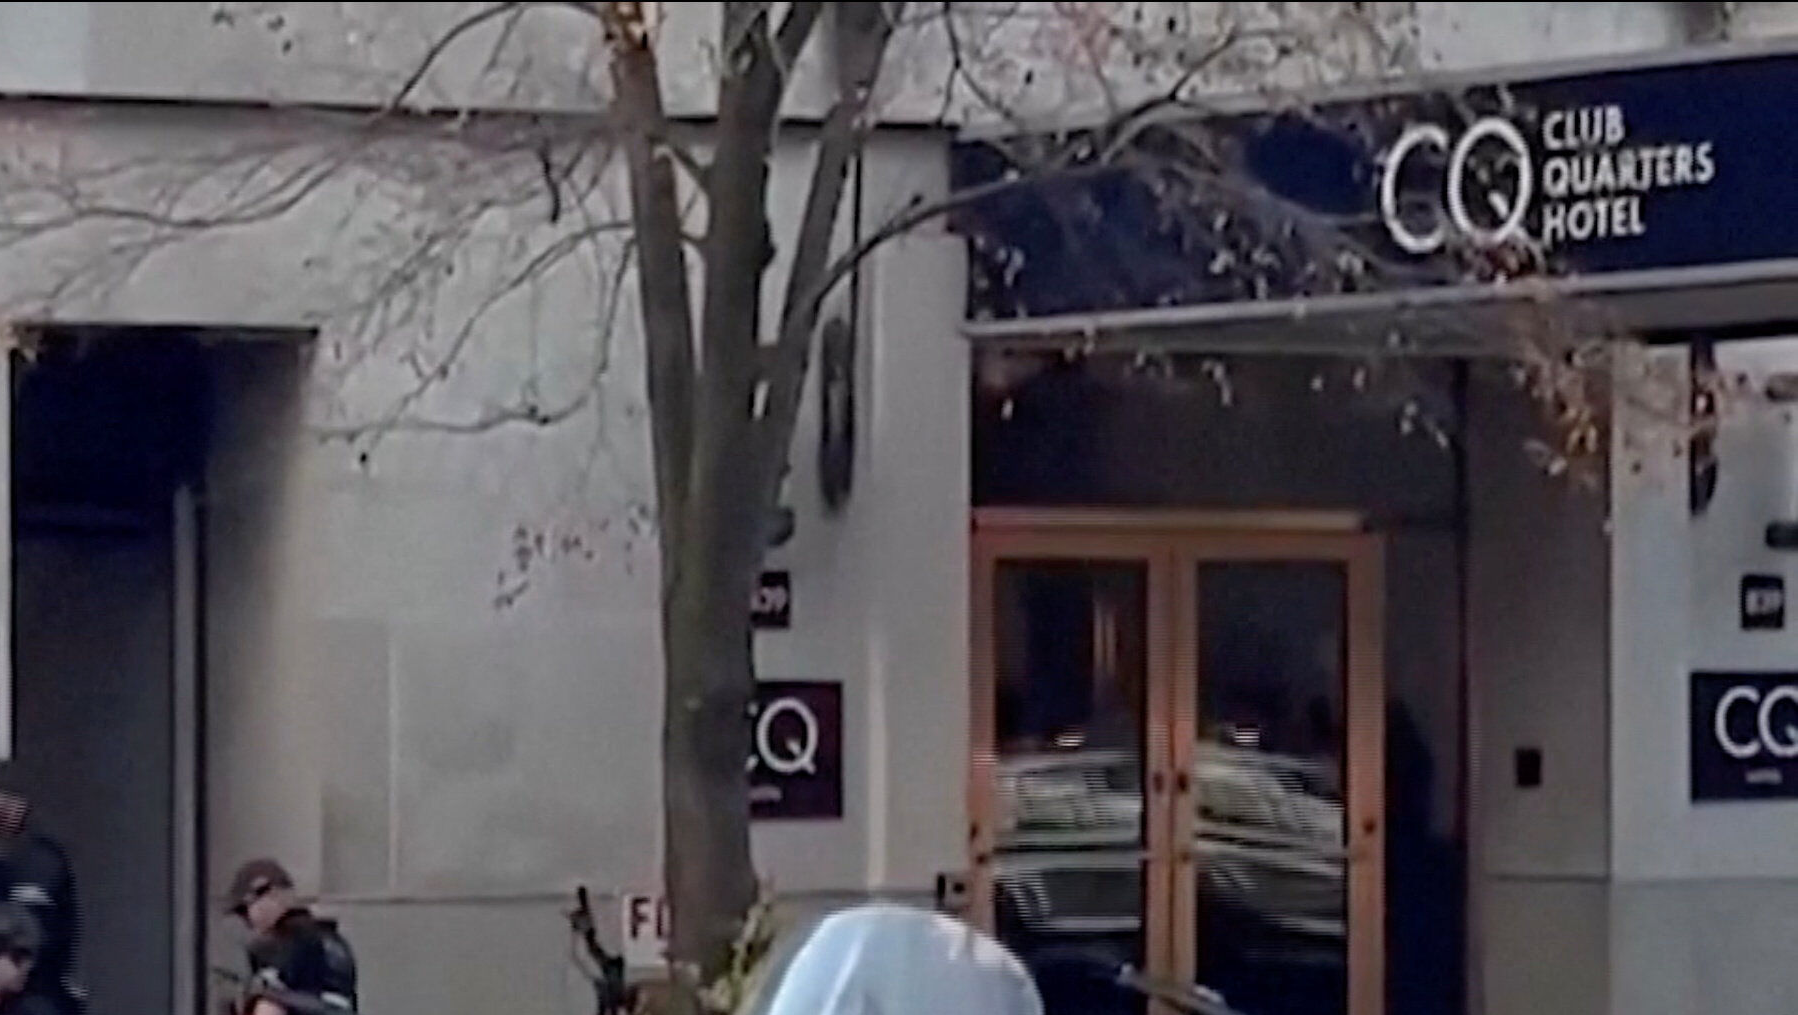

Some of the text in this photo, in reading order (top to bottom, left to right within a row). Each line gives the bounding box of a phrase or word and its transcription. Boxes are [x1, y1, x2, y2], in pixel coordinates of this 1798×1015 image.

[1542, 104, 1626, 151] CLUB
[1380, 116, 1536, 254] CQ
[1542, 141, 1716, 198] QUARTERS
[1542, 195, 1647, 246] HOTEL
[745, 696, 819, 775] Q
[1715, 685, 1798, 759] CQ
